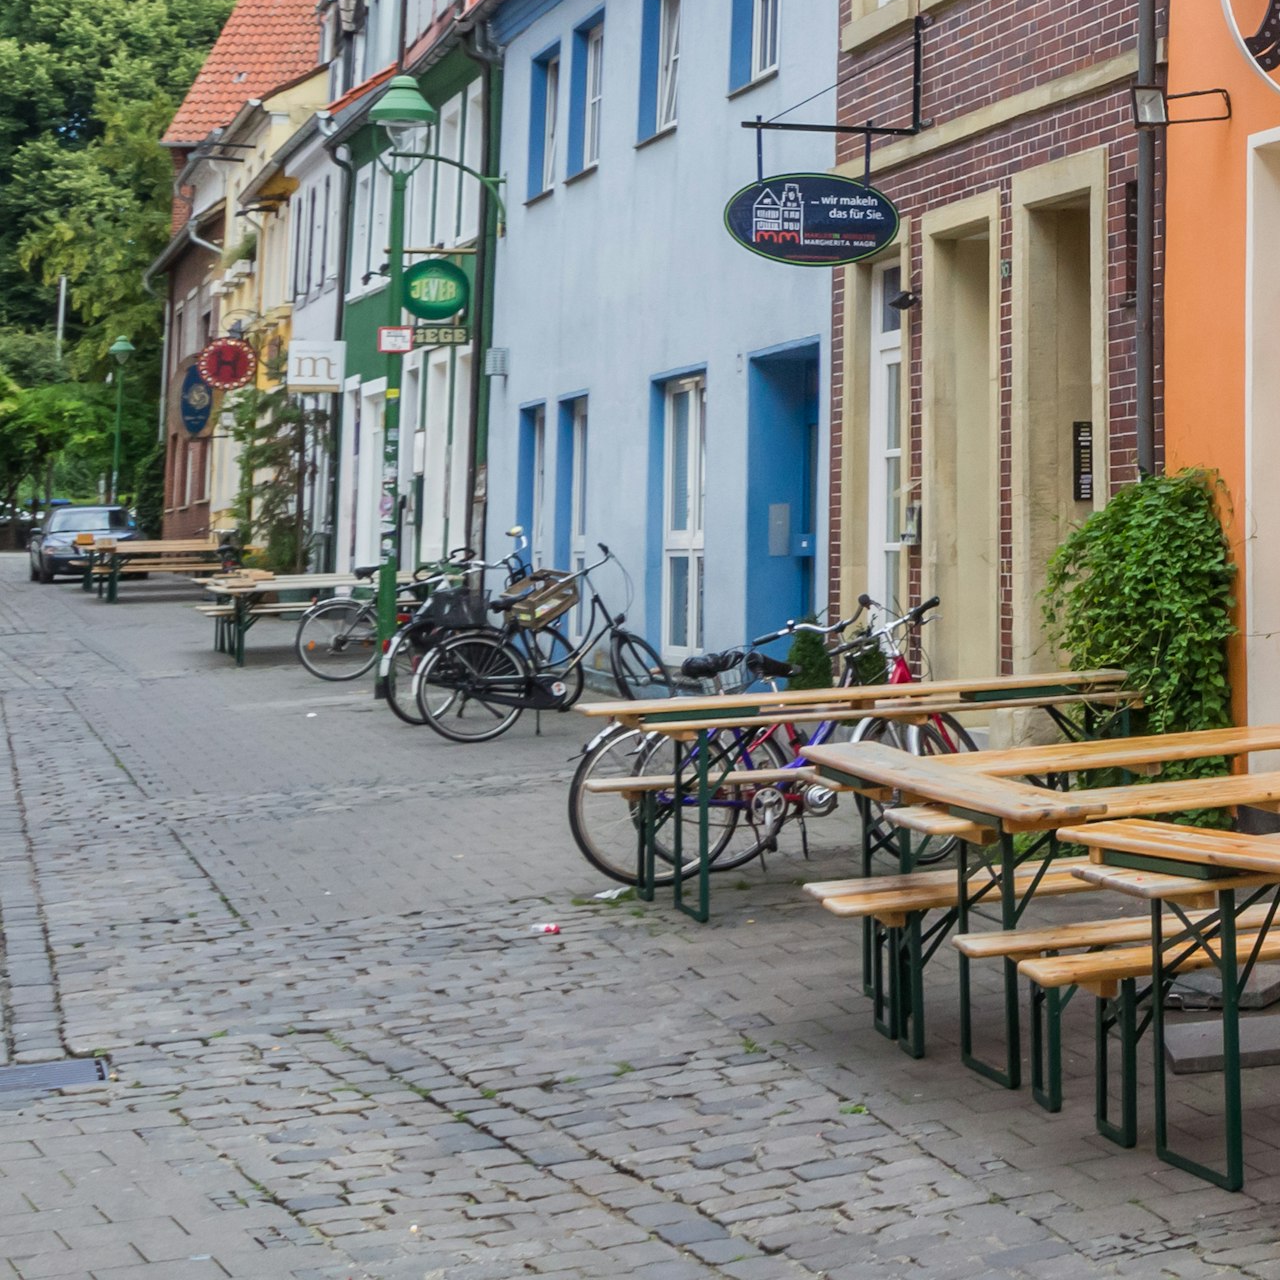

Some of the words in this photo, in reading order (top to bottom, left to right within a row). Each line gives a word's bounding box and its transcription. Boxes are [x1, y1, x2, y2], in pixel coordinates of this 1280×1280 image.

[820, 194, 839, 205] wir
[839, 195, 878, 207] makeln
[828, 207, 848, 219] das
[849, 207, 865, 220] für
[866, 208, 885, 220] Sie.
[410, 277, 457, 301] JEVER
